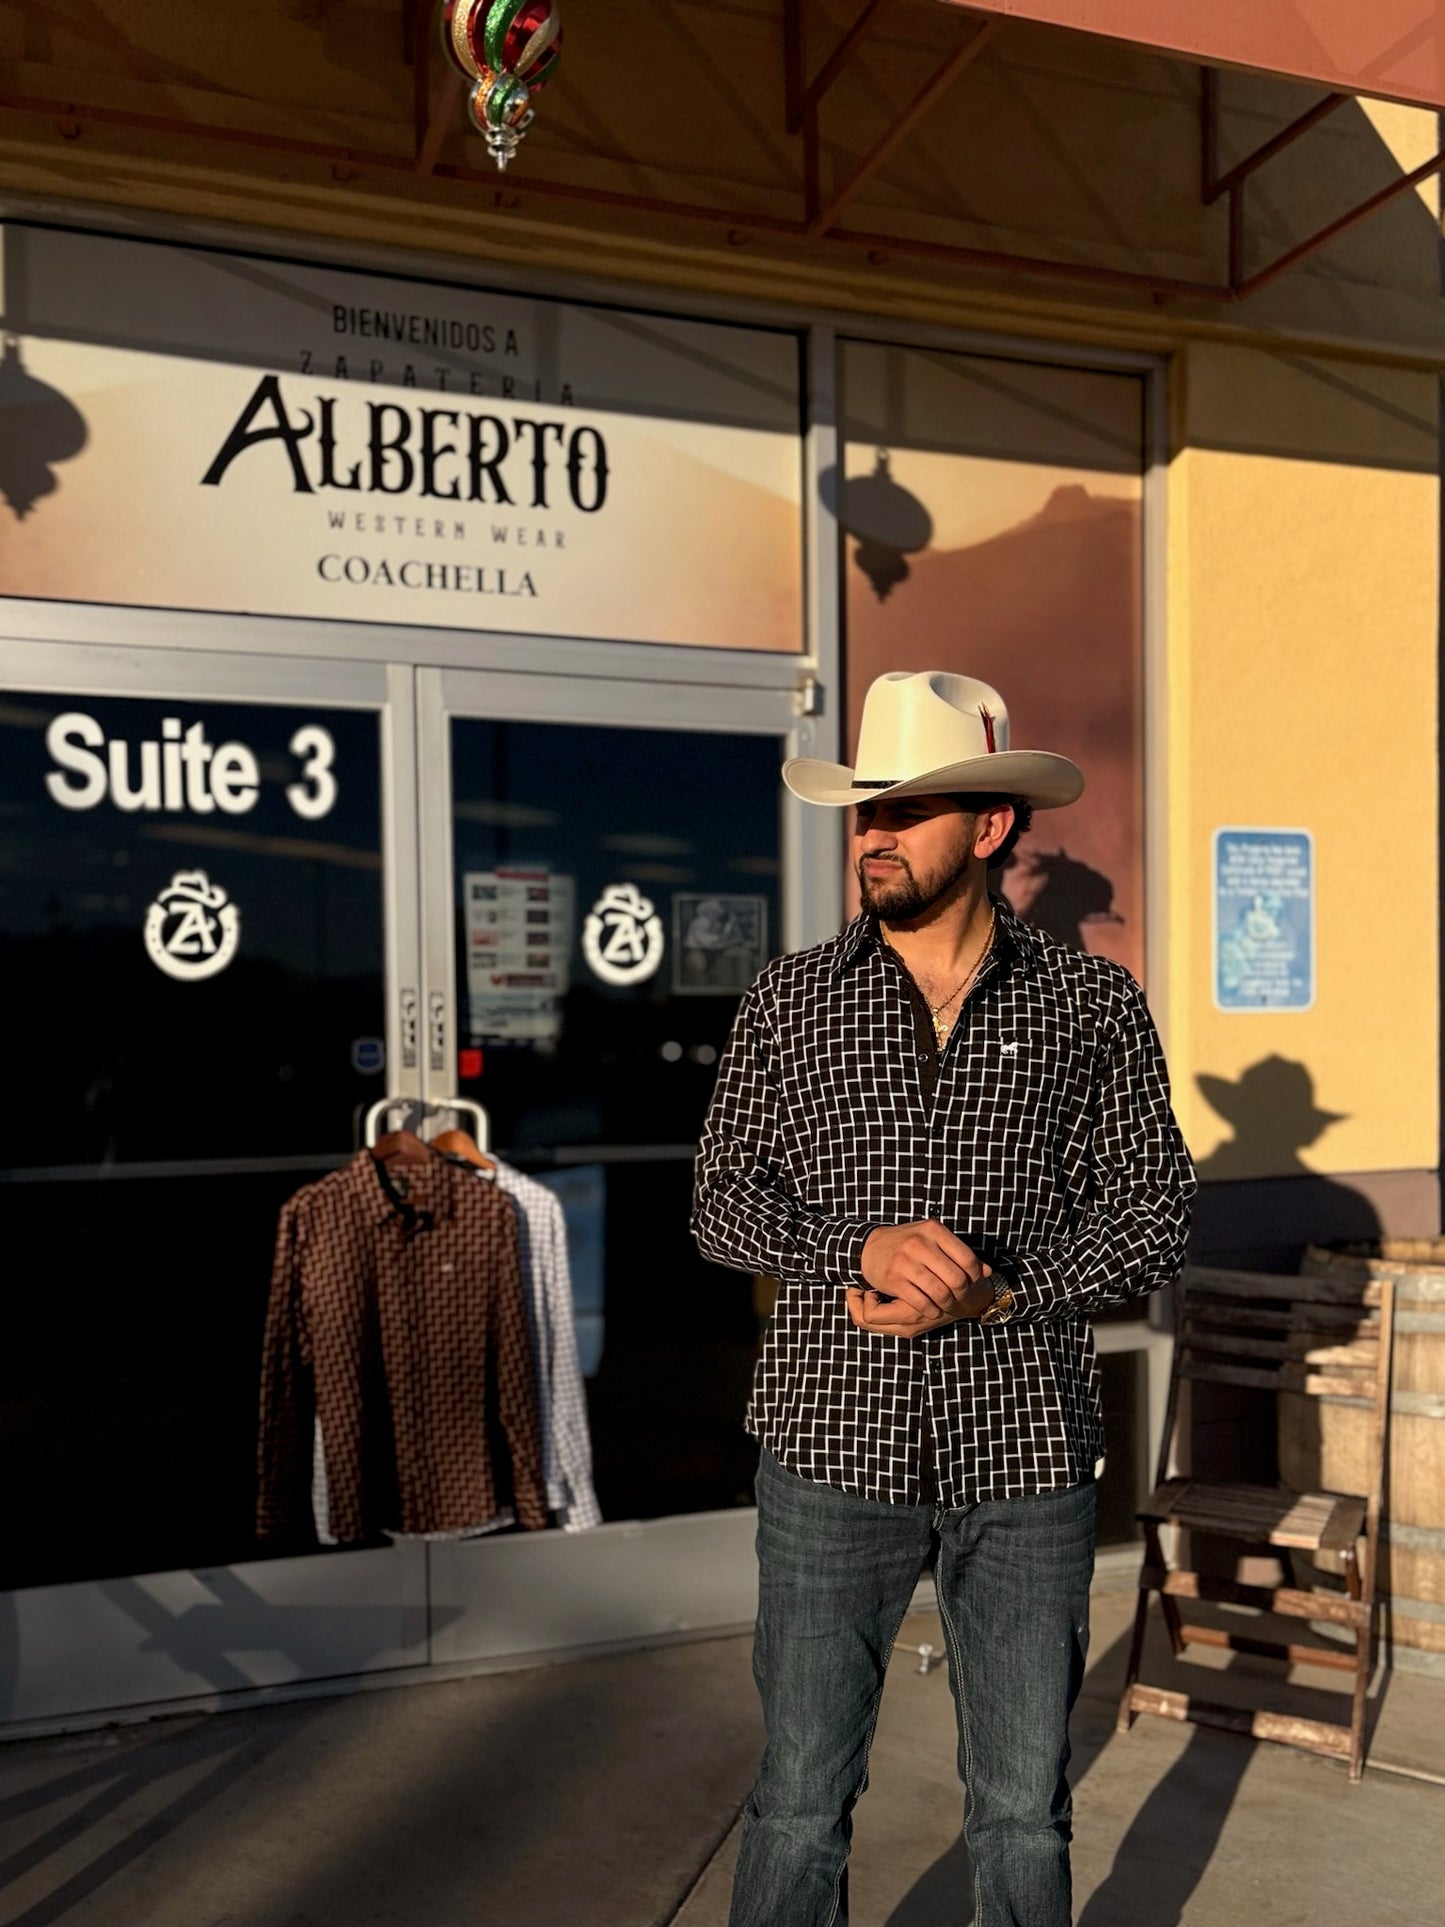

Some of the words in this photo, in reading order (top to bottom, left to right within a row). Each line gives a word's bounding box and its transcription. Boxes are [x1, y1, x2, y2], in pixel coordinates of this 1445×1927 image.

[333, 305, 496, 353] BIENVENIDOS
[504, 329, 519, 357] A
[300, 350, 575, 406] ZAPATERIA
[200, 375, 609, 513] ALBERTO
[328, 510, 467, 541] WESTERN
[491, 524, 567, 550] WEAR
[316, 554, 539, 598] COACHELLA
[46, 711, 260, 815] Suite
[286, 725, 338, 819] 3
